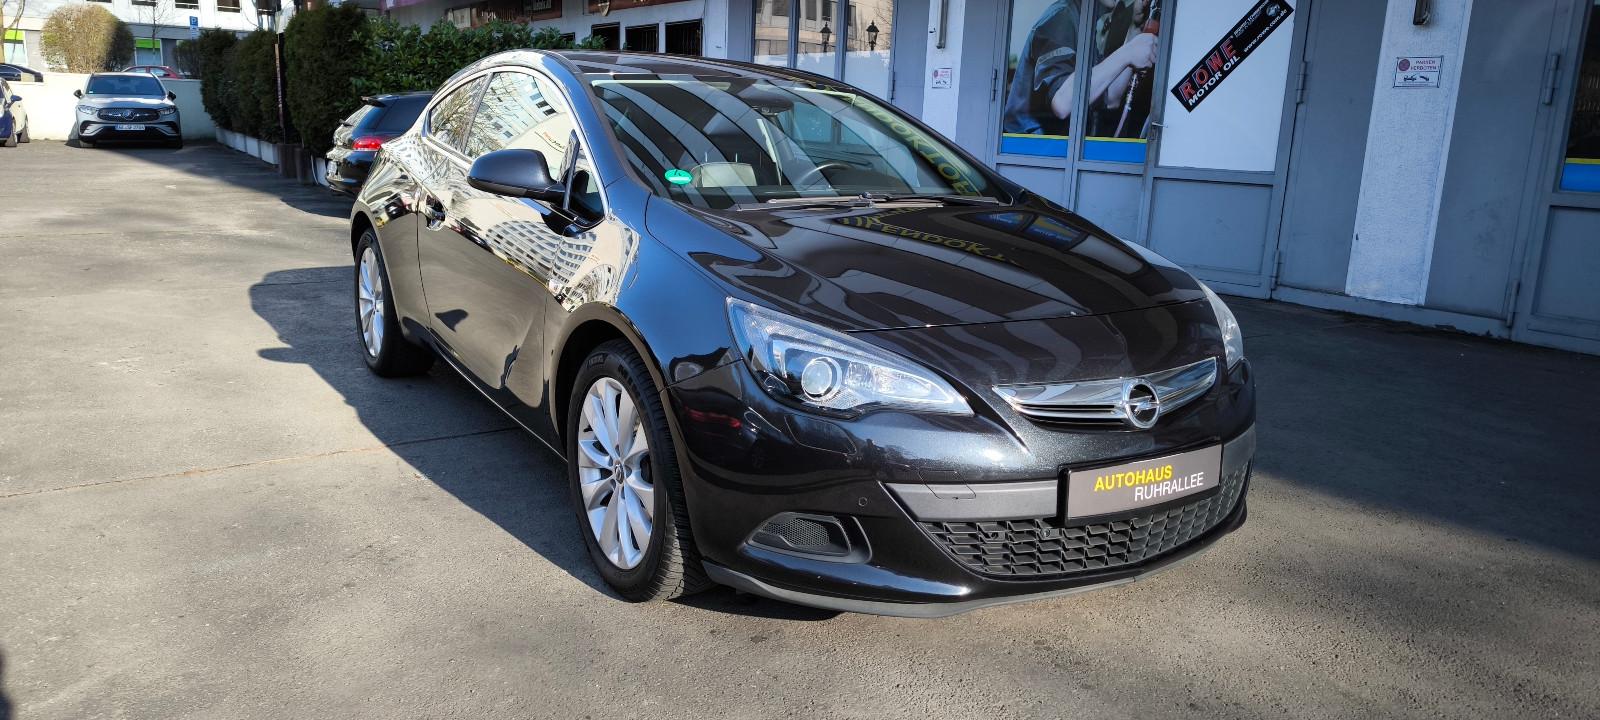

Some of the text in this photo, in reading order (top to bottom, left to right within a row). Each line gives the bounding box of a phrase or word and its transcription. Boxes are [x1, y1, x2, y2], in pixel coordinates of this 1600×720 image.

[1188, 56, 1240, 106] MOTOR OIL
[1094, 465, 1172, 491] AUTOHAUS
[1134, 472, 1204, 501] RUHRALLEE
